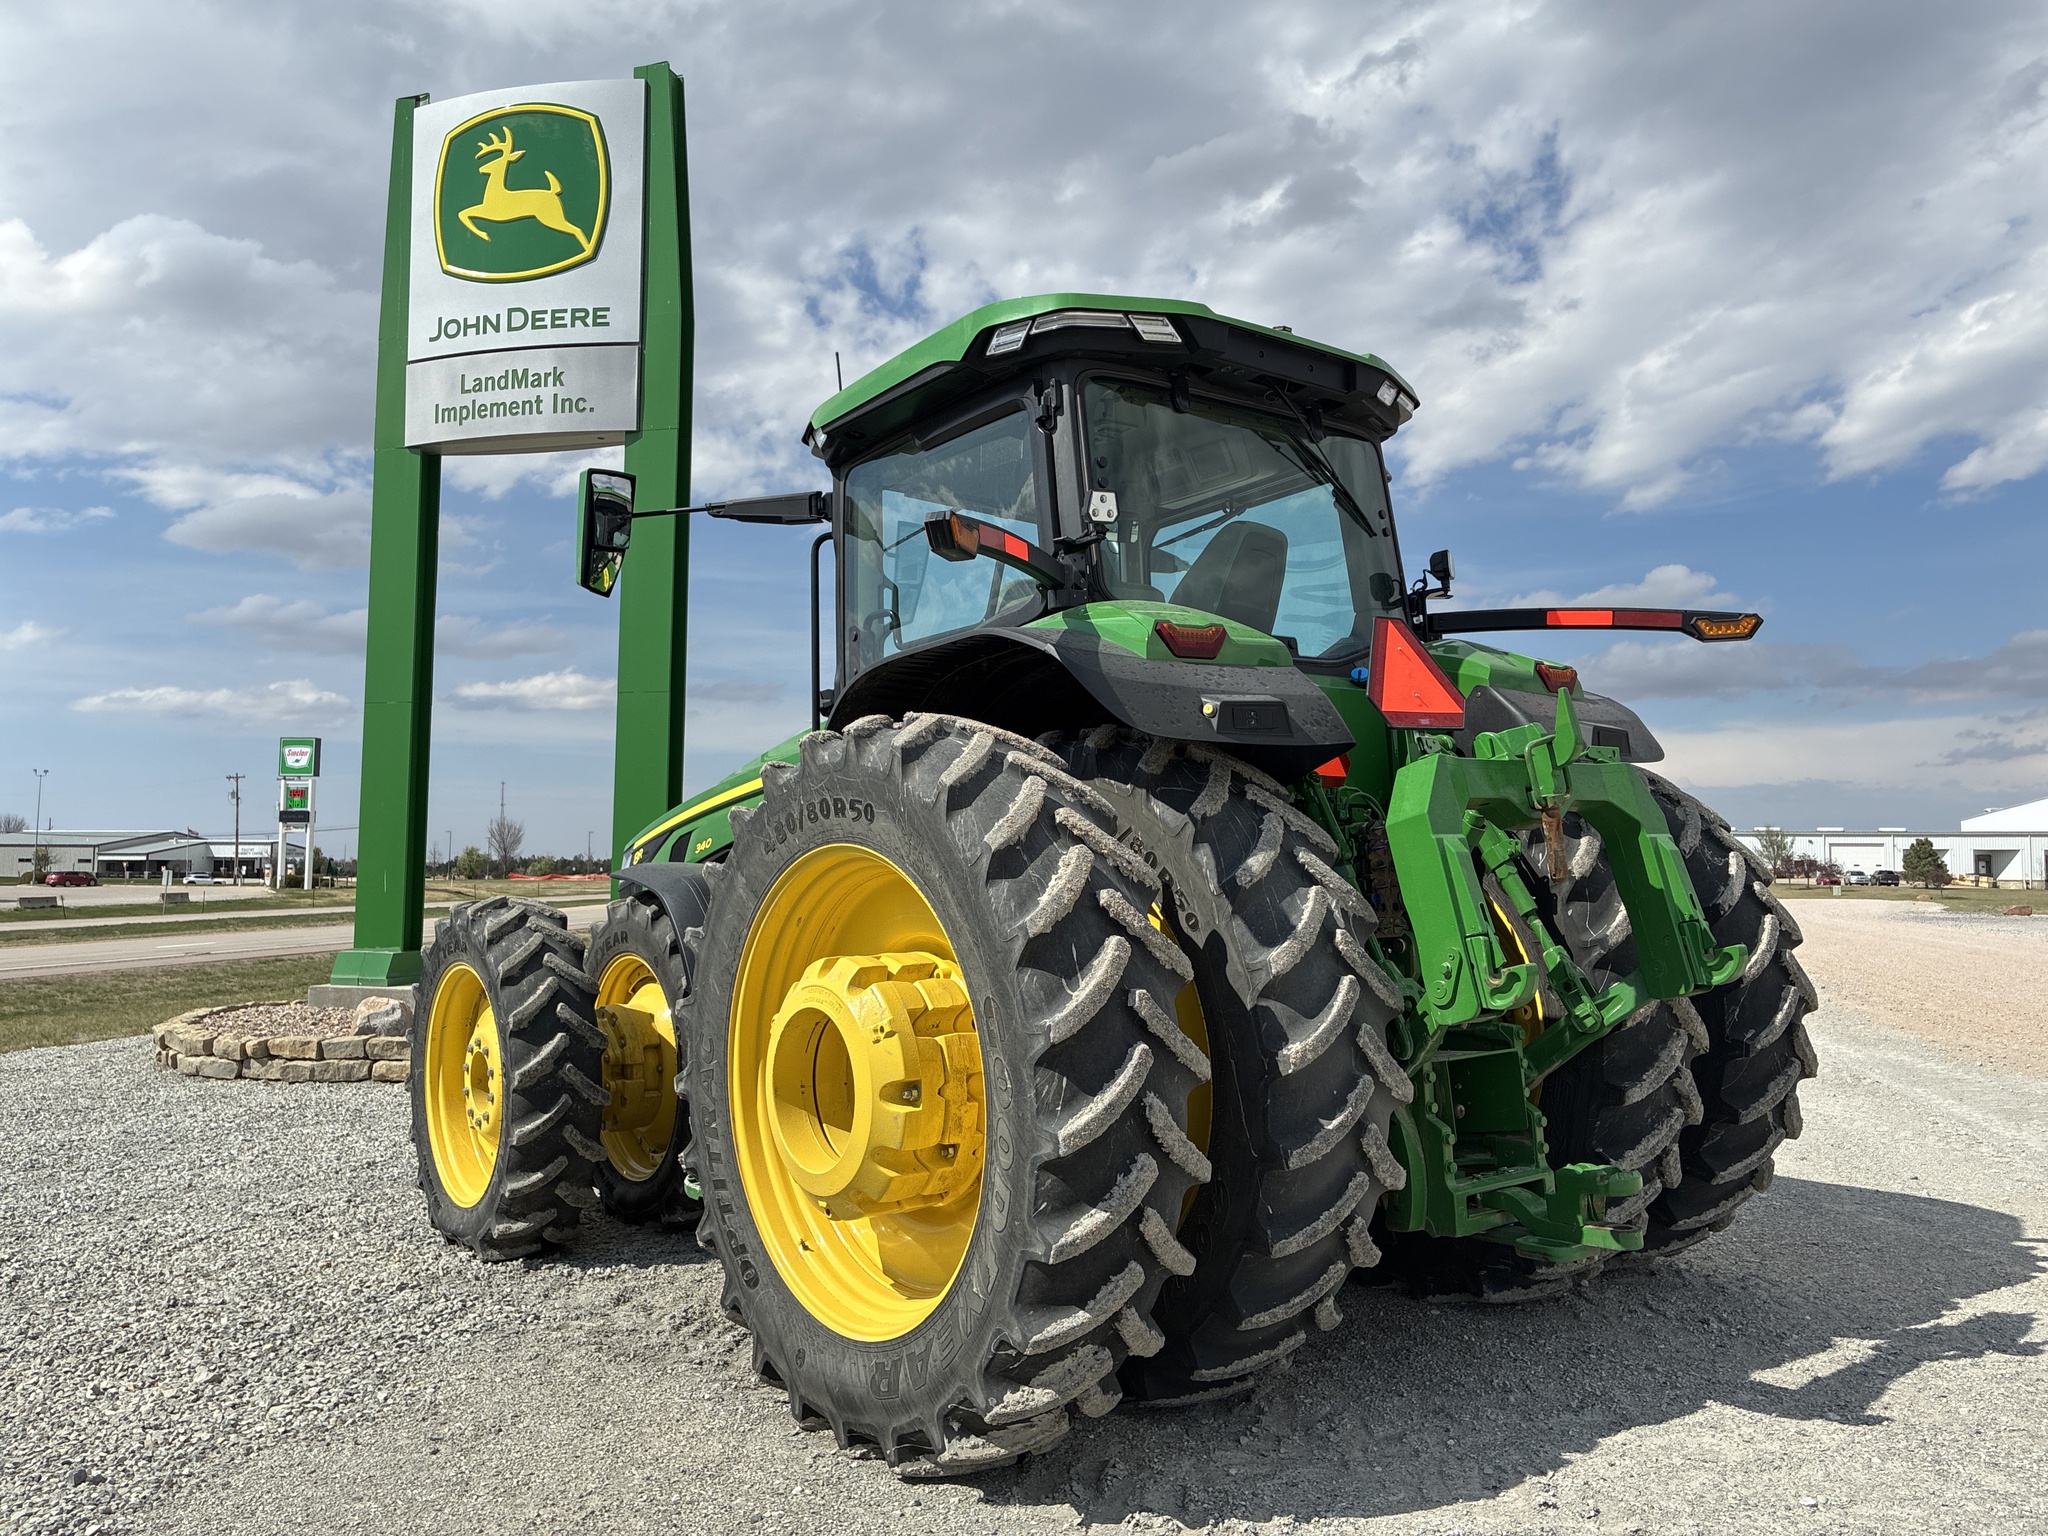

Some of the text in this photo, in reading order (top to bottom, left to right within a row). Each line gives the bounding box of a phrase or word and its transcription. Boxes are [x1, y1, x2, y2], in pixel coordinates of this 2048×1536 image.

[429, 307, 610, 342] JOHN DEERE
[460, 366, 565, 394] LandMark
[434, 393, 595, 426] Implement Inc.
[287, 748, 309, 757] Sinclair
[764, 797, 875, 855] 480/80R50
[633, 848, 644, 865] 8R
[695, 837, 712, 854] 340
[700, 1030, 761, 1291] OPTITRAC
